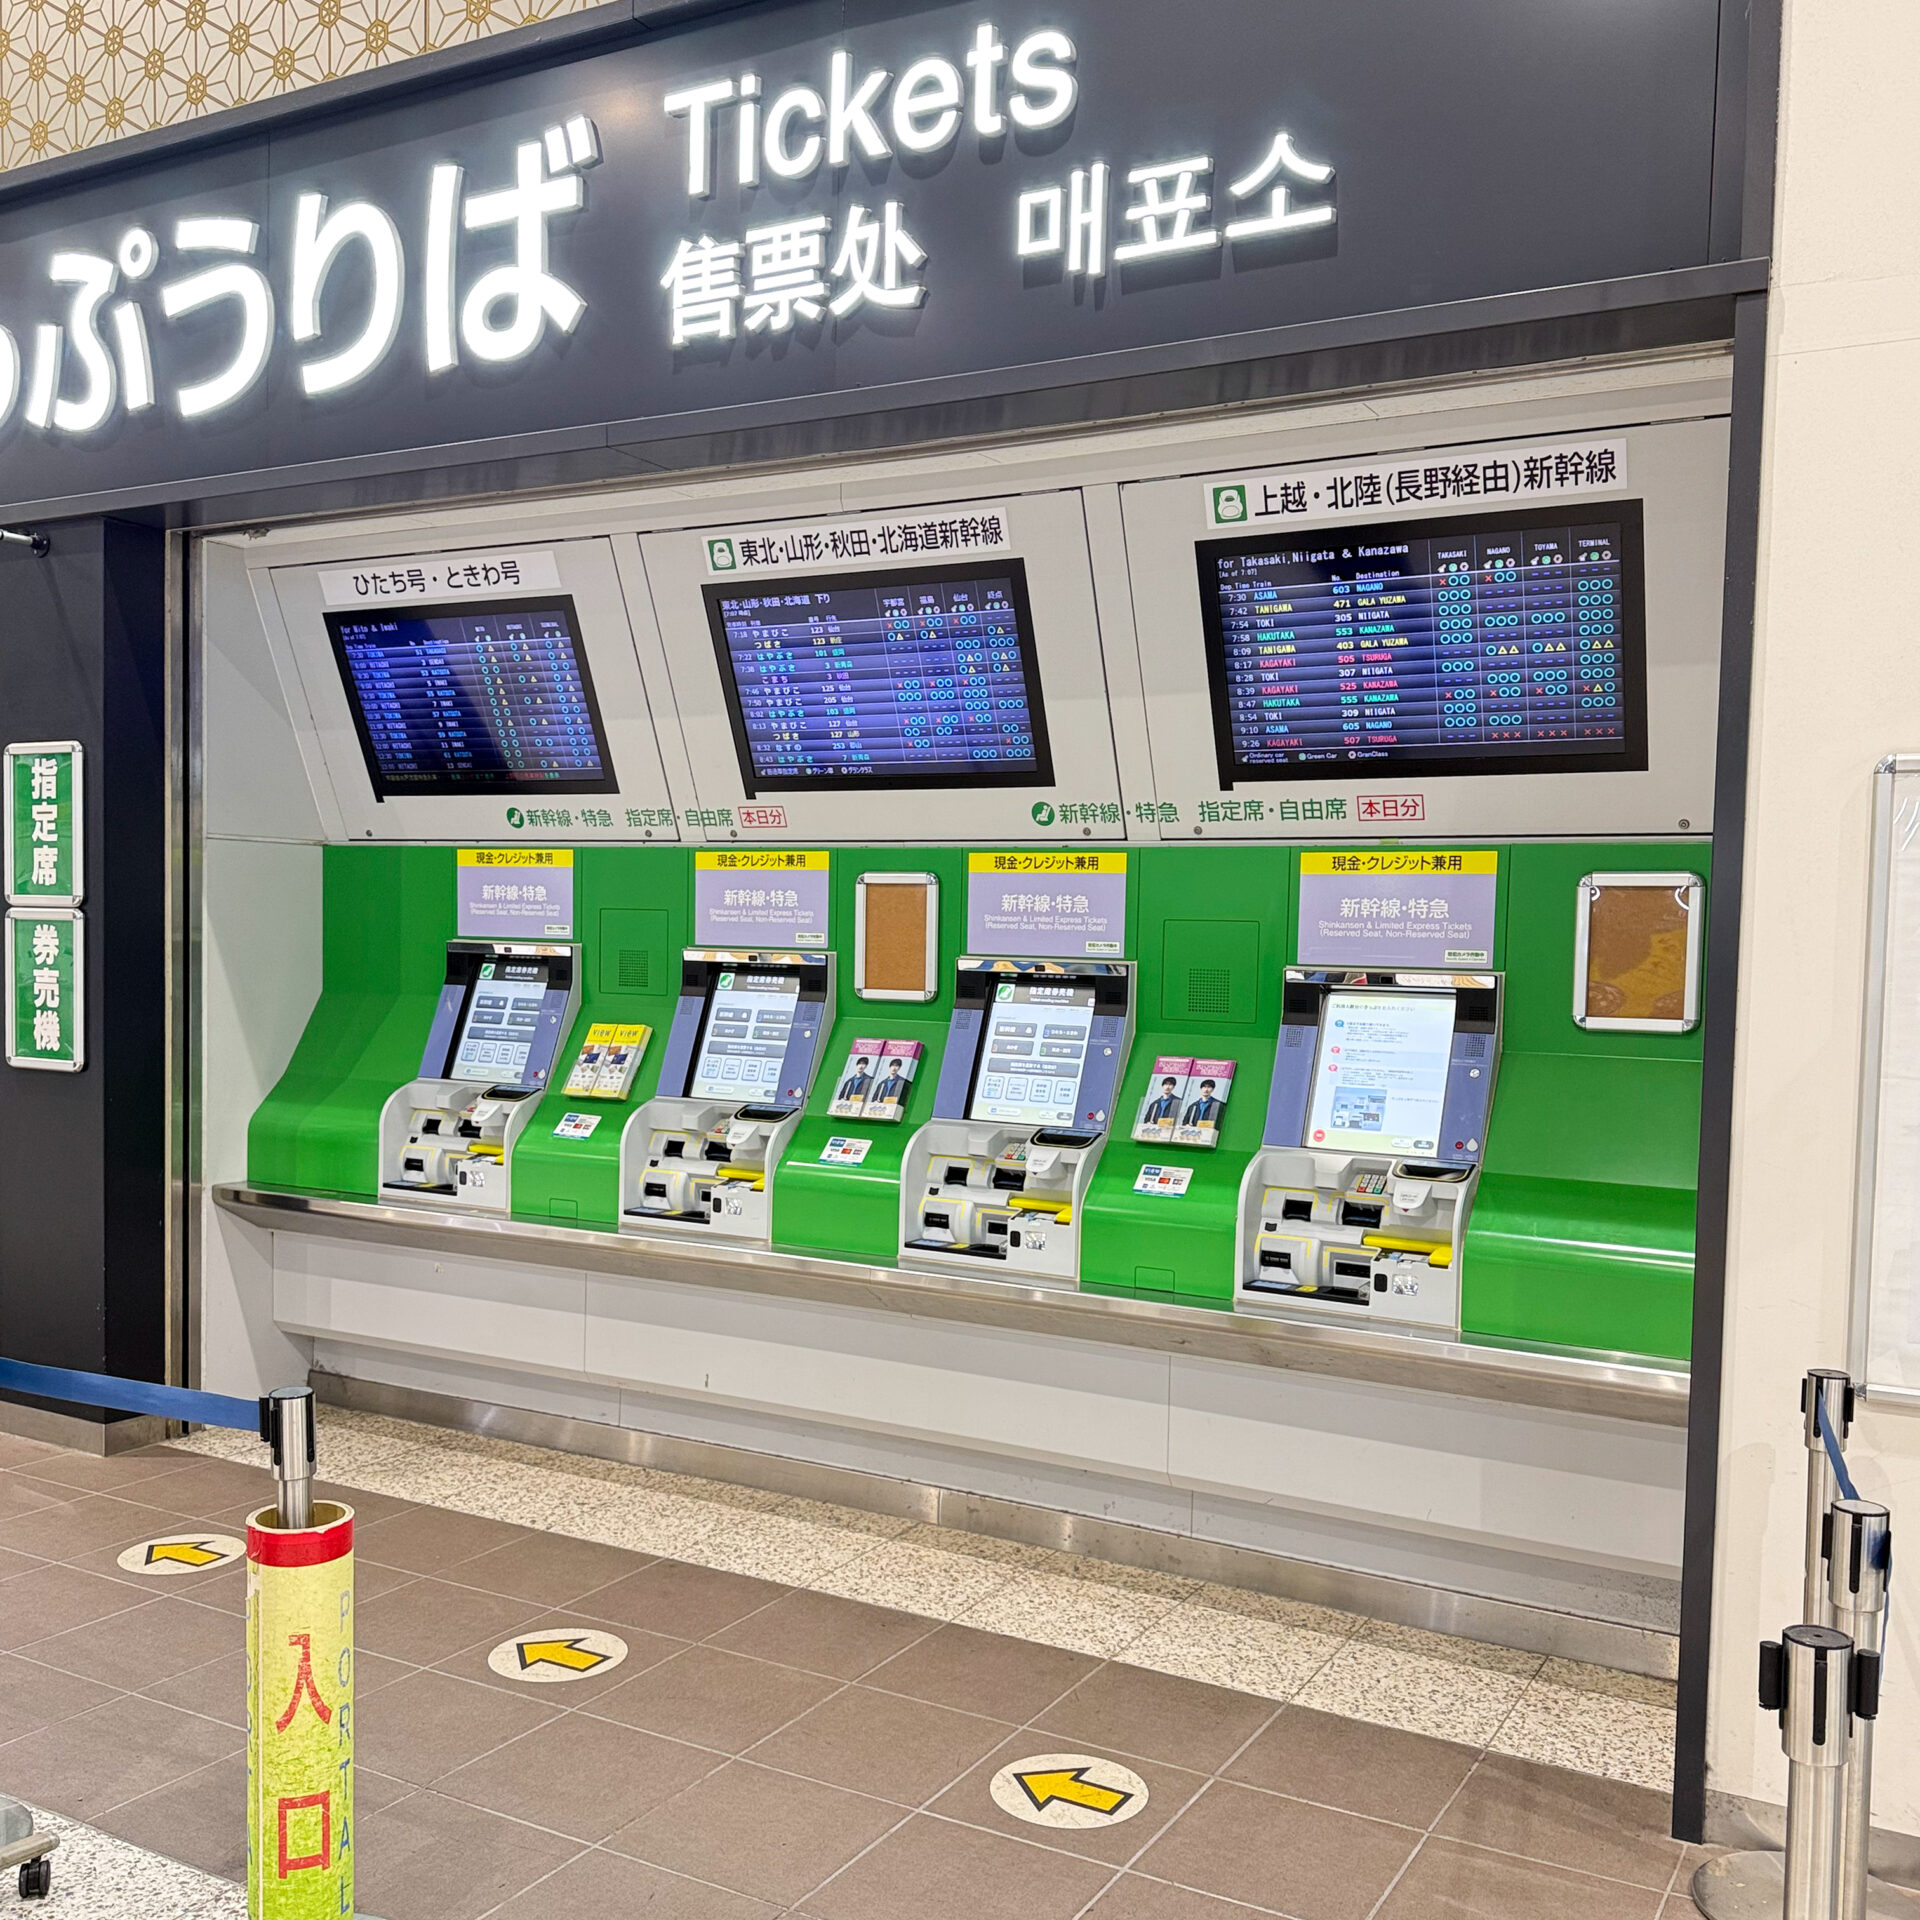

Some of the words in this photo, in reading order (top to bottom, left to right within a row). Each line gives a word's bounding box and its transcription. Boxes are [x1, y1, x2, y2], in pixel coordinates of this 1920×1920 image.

[663, 22, 1077, 198] Tickets
[1016, 130, 1336, 277] 매표소
[660, 200, 930, 349] 售票处
[1254, 448, 1618, 517] 上越・北陸(長野経由)新幹線
[739, 515, 1003, 566] 東北・山形・秋田・北海道新幹線
[1534, 542, 1558, 551] TOYAMA
[1578, 537, 1610, 547] TERMINAL
[1217, 557, 1234, 569] for
[1341, 548, 1353, 558] &
[1358, 543, 1408, 557] Kanazawa
[1437, 549, 1467, 559] TAKASAKI
[1486, 546, 1511, 555] NAGANO
[353, 560, 520, 596] ひたち号・ときわ号
[1355, 569, 1399, 579] Destination
[1252, 579, 1271, 587] Train
[814, 592, 831, 603] 下り
[1228, 593, 1247, 602] 7:30
[1253, 590, 1277, 600] ASAMA
[1332, 584, 1350, 594] 603
[1356, 582, 1383, 592] NAGANO
[1229, 606, 1248, 615] 7:42
[1254, 603, 1292, 613] TANIGAWA
[1333, 598, 1351, 608] 471
[1357, 597, 1375, 606] GALA
[1378, 594, 1406, 604] YUZAWA
[1230, 620, 1249, 629] 7:54
[1255, 618, 1274, 627] TOKI
[1334, 613, 1352, 622] 305
[1358, 610, 1389, 620] NIIGATA
[751, 628, 789, 638] やまびこ
[1231, 633, 1250, 642] 7:58
[1256, 630, 1295, 640] HAKUTAKA
[1335, 626, 1353, 635] 553
[1358, 624, 1394, 634] KANAZAWA
[754, 640, 781, 649] つばさ
[812, 637, 826, 645] 123
[1233, 647, 1251, 655] 8:09
[1257, 643, 1296, 654] TANIGAWA
[1336, 640, 1354, 649] 403
[1360, 638, 1378, 647] GALA
[1381, 637, 1408, 646] YUZAWA
[756, 651, 793, 661] はやぶさ
[1234, 660, 1253, 669] 8:17
[1258, 657, 1296, 667] KAGAYAKI
[1337, 654, 1355, 663] 505
[1360, 652, 1392, 661] TSURUGA
[758, 663, 795, 673] はやぶさ
[1235, 673, 1254, 682] 8:28
[1260, 672, 1279, 680] TOKI
[1338, 667, 1356, 676] 307
[1361, 665, 1393, 675] NIIGATA
[763, 686, 800, 695] やまびこ
[821, 684, 834, 692] 125
[1236, 687, 1255, 695] 8:39
[1261, 684, 1298, 694] KAGAYAKI
[1339, 681, 1357, 690] 525
[1362, 679, 1398, 688] KANAZAWA
[765, 697, 802, 706] やまびこ
[1237, 700, 1256, 708] 8:47
[1262, 697, 1300, 707] HAKUTAKA
[1340, 695, 1357, 703] 555
[1363, 693, 1399, 702] KANAZAWA
[767, 709, 804, 718] はやぶさ
[1239, 713, 1257, 721] 8:54
[1263, 711, 1282, 720] TOKI
[1341, 708, 1358, 716] 309
[1364, 706, 1395, 715] NIIGATA
[770, 721, 807, 730] やまびこ
[1240, 726, 1258, 734] 9:10
[1264, 724, 1288, 733] ASAMA
[1342, 721, 1359, 730] 605
[1365, 720, 1392, 729] NAGANO
[772, 732, 799, 740] つばさ
[1241, 739, 1259, 747] 9:26
[1265, 737, 1302, 746] KAGAYAKI
[1343, 735, 1360, 744] 507
[1366, 734, 1397, 743] TSURUGA
[776, 755, 813, 763] はやぶさ
[526, 808, 613, 828] 新幹線・特急
[625, 808, 734, 828] 指定席・自由席
[742, 809, 783, 826] 本日分
[1058, 801, 1180, 825] 新幹線・特急
[1198, 798, 1347, 823] 指定席・自由席
[1361, 798, 1420, 819] 本日分
[31, 758, 58, 886] 指定席
[717, 854, 806, 867] 現金・クレジット兼用
[994, 856, 1099, 870] 現金・クレジット兼用
[1332, 855, 1462, 871] 現金・クレジット兼用
[482, 885, 547, 901] 新幹線・特急
[724, 889, 798, 907] 新幹線・特急
[1001, 894, 1089, 913] 新幹線・特急
[1340, 898, 1449, 919] 新幹線・特急
[1320, 929, 1360, 938] (Reserved
[1386, 930, 1444, 939] Non-Reserved
[1375, 922, 1404, 930] Limited
[1407, 922, 1440, 932] Express
[1442, 922, 1472, 931] Tickets
[32, 924, 61, 1052] 券売機
[337, 1589, 351, 1914] PORTAL
